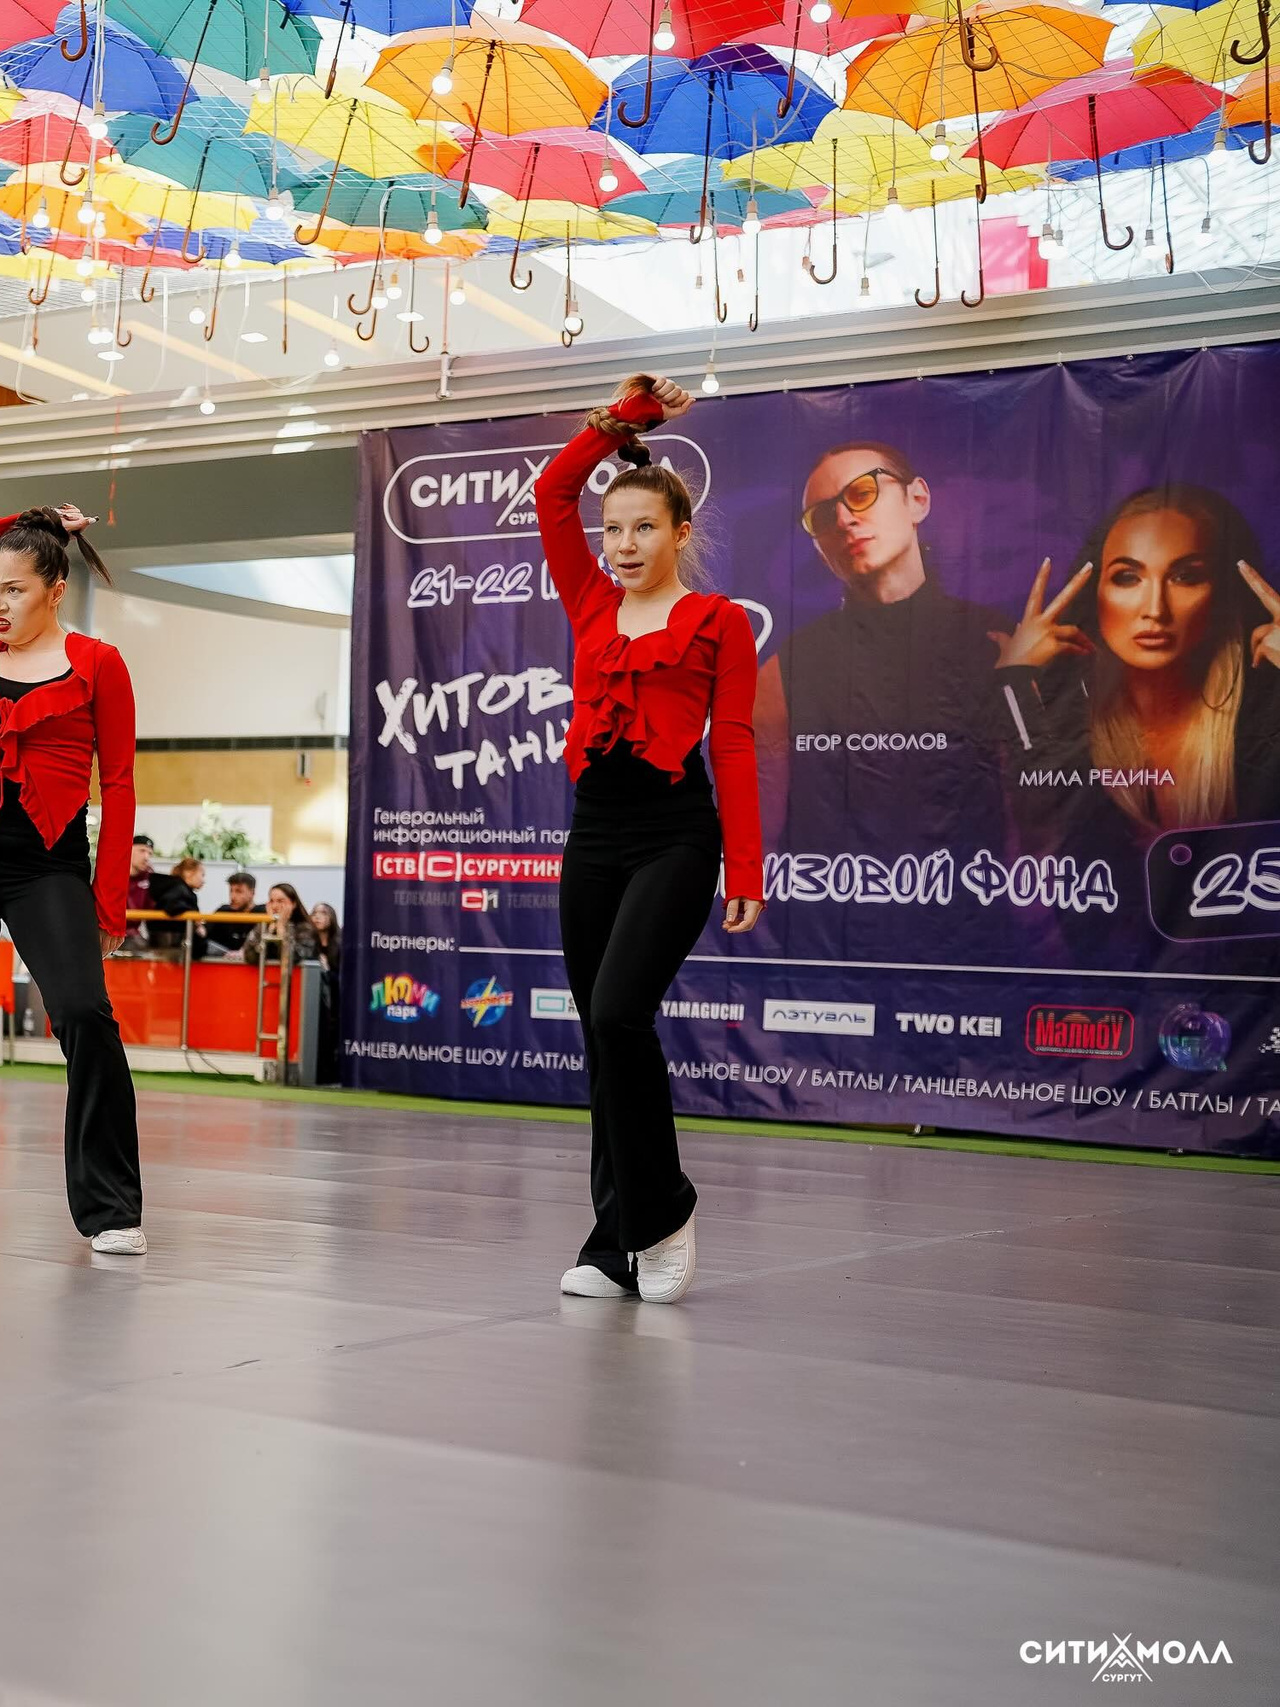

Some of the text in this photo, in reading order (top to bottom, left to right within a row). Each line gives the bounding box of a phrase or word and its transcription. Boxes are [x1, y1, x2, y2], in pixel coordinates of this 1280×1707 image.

[410, 470, 520, 508] СИТИ
[407, 562, 534, 609] 21-22
[375, 667, 574, 754] ХИТОВ
[795, 732, 948, 752] ЕГОР СОКОЛОВ
[1019, 767, 1175, 788] МИЛА РЕДИНА
[373, 807, 485, 827] Генеральный
[373, 826, 536, 846] информационный
[463, 857, 562, 878] СУРГУТИН
[762, 849, 954, 905] ИЗОВОЙ
[960, 848, 1119, 914] ФОНД
[371, 932, 455, 952] Партнеры:
[387, 1005, 418, 1020] парк
[661, 1000, 745, 1021] YAMAGUCHI
[895, 1012, 1002, 1037] TWO KEI
[344, 1039, 462, 1064] ТАНЦЕВАЛЬНОЕ
[465, 1048, 508, 1067] ШОУ
[522, 1050, 584, 1072] БАТТЛЫ
[667, 1060, 740, 1081] АЛЬНОЕ
[744, 1064, 793, 1085] ШОУ
[811, 1068, 883, 1091] БАТТЛЫ
[903, 1074, 1066, 1103] ТАНЦЕВАЛЬНОЕ
[1072, 1086, 1127, 1107] ШОУ
[1149, 1090, 1233, 1114] БАТТЛЫ
[1257, 1097, 1280, 1116] ТА
